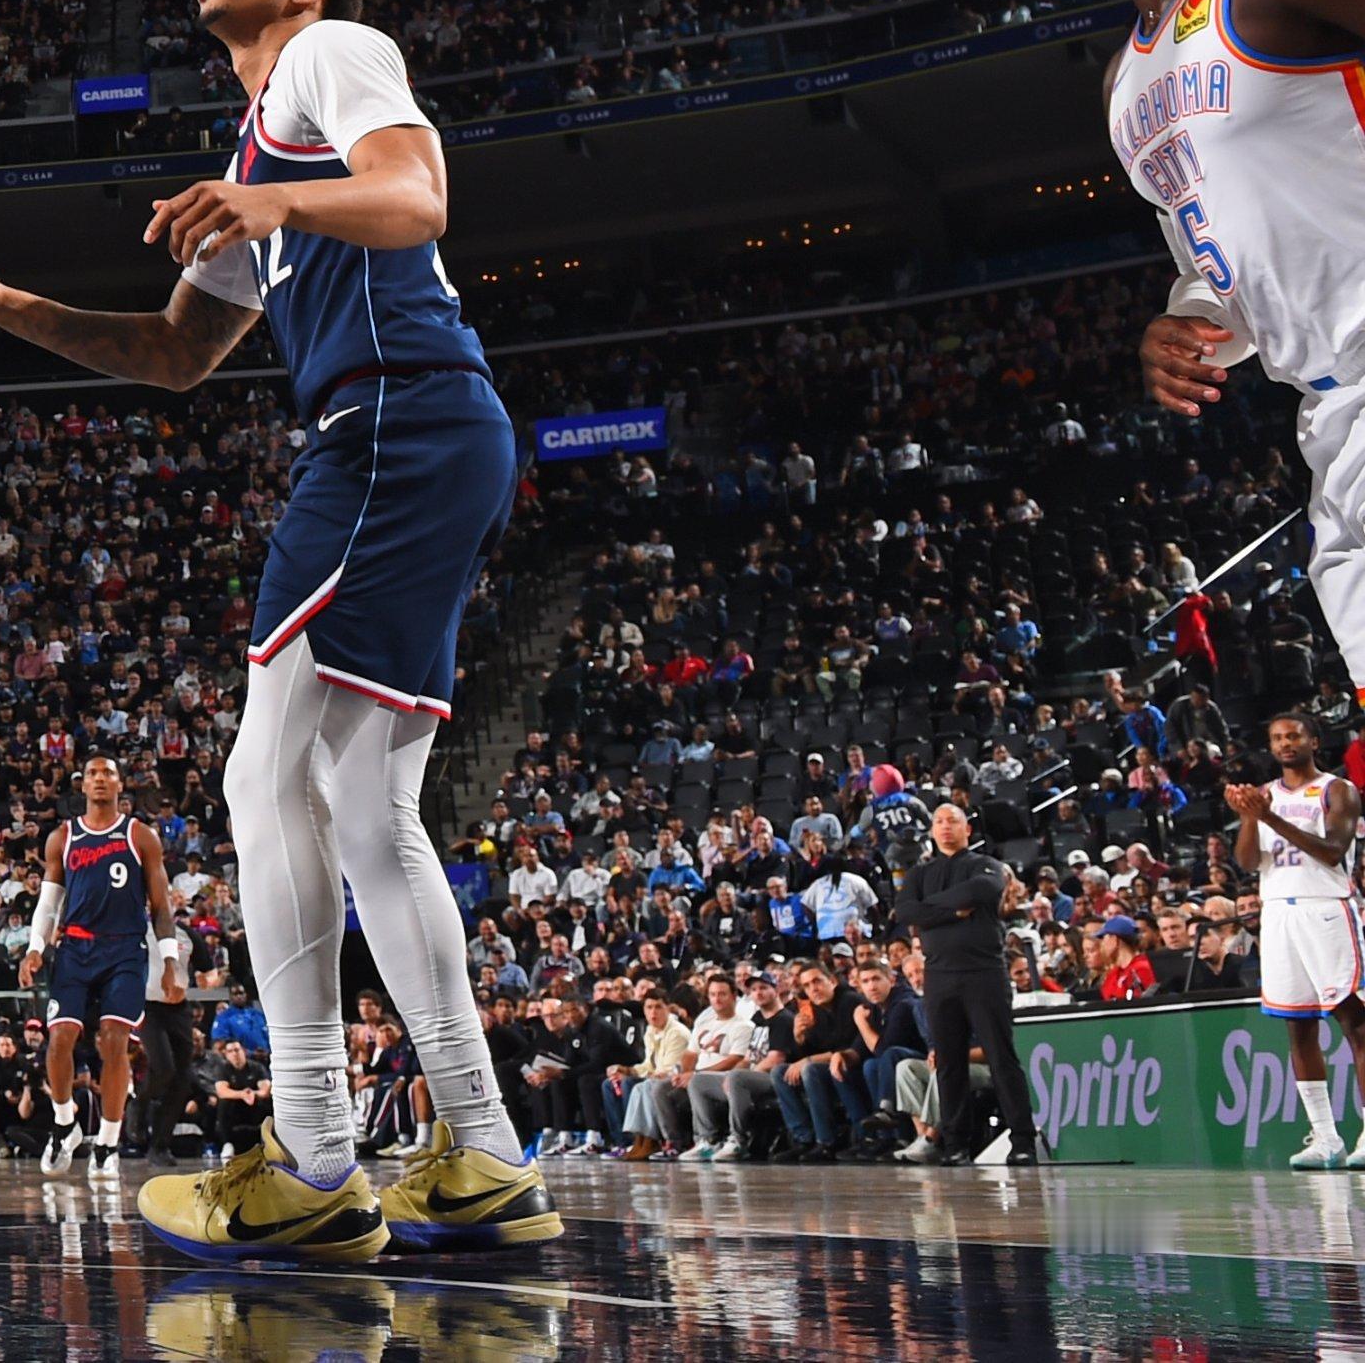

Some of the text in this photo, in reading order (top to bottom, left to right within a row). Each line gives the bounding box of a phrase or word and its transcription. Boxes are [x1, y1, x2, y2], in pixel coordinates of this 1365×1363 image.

[1056, 18, 1092, 33] CLEAR
[22, 172, 54, 182] CLEAR
[129, 163, 162, 173] CLEAR
[1139, 129, 1204, 206] CITY
[1173, 193, 1236, 297] 5
[109, 862, 128, 889] 9
[1029, 1033, 1162, 1149] Sprite
